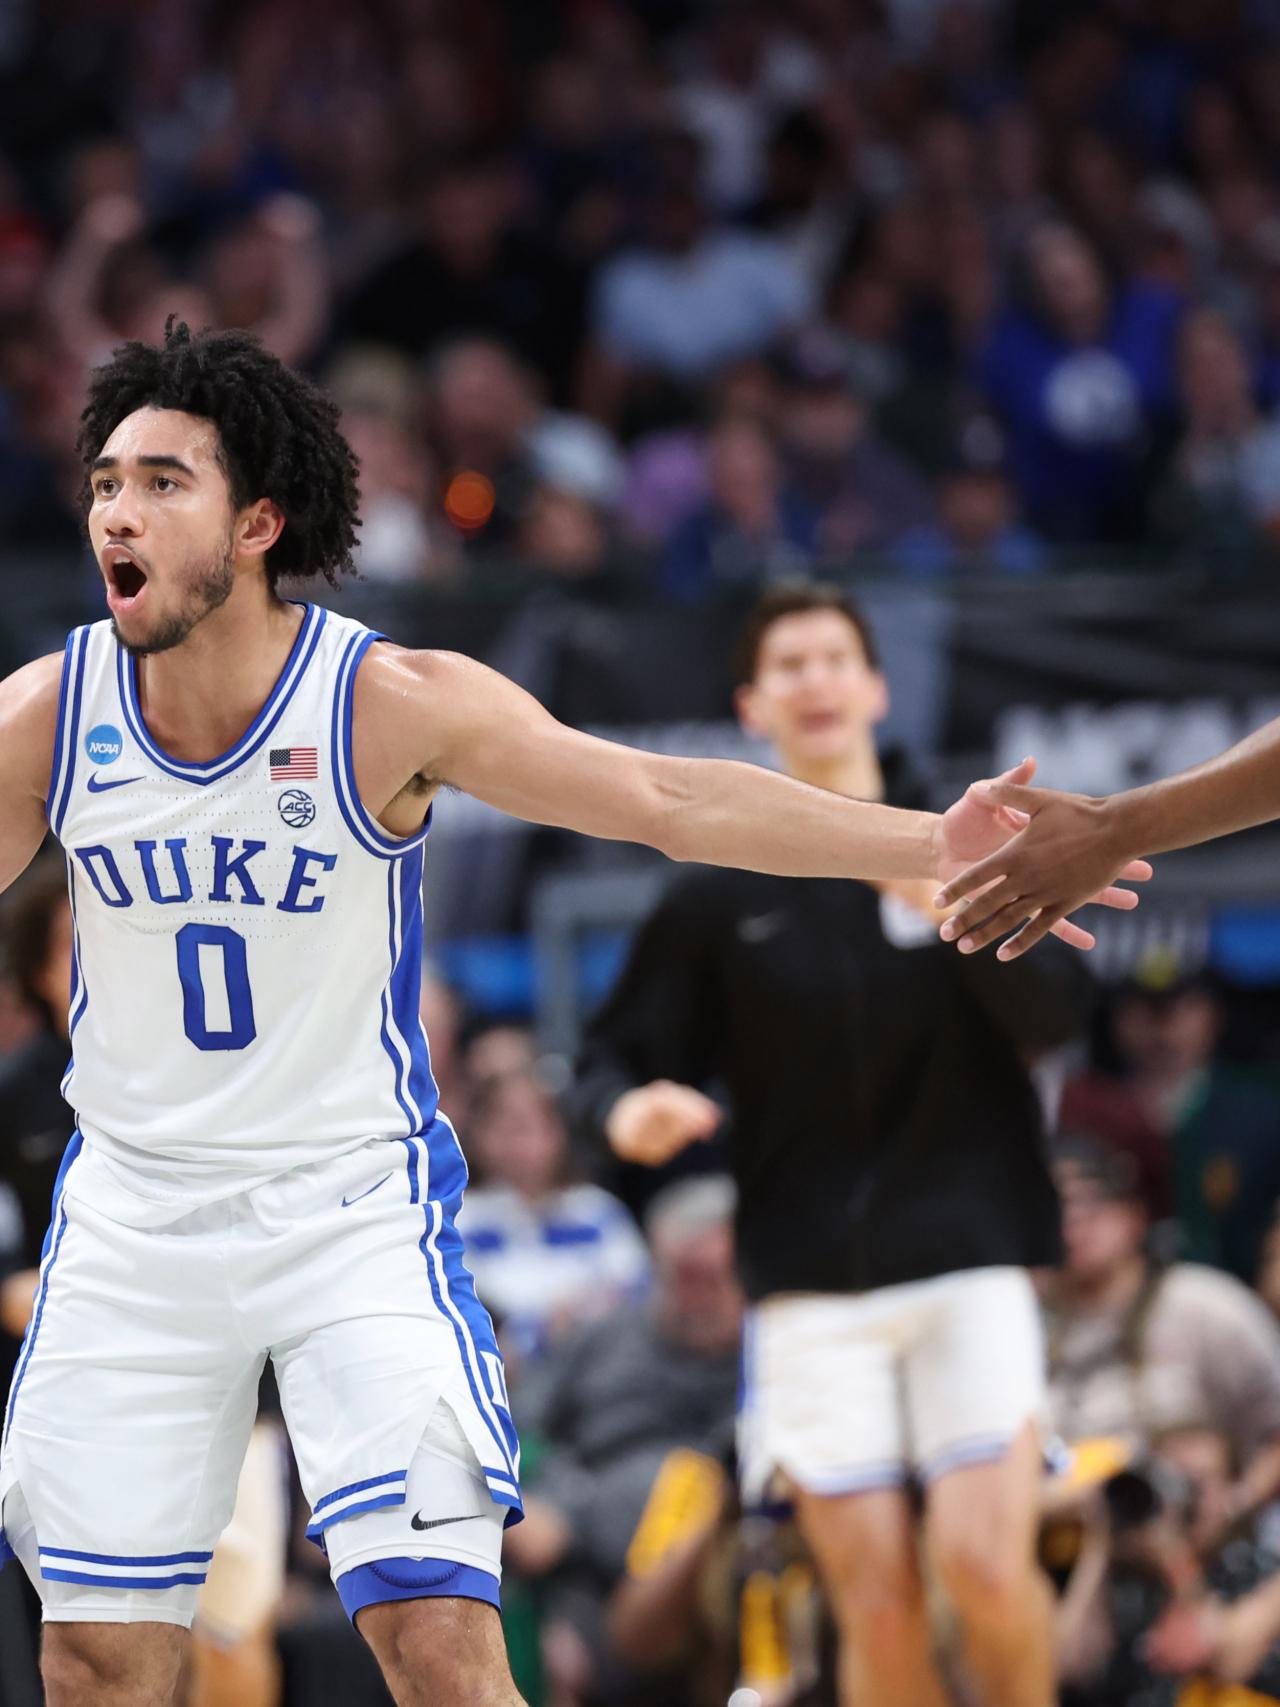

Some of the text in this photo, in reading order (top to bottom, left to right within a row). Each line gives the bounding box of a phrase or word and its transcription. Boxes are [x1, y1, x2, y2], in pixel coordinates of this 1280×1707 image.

[89, 742, 119, 754] NCAA
[283, 802, 312, 813] ACC
[74, 835, 338, 913] DUKE
[175, 922, 257, 1051] 0
